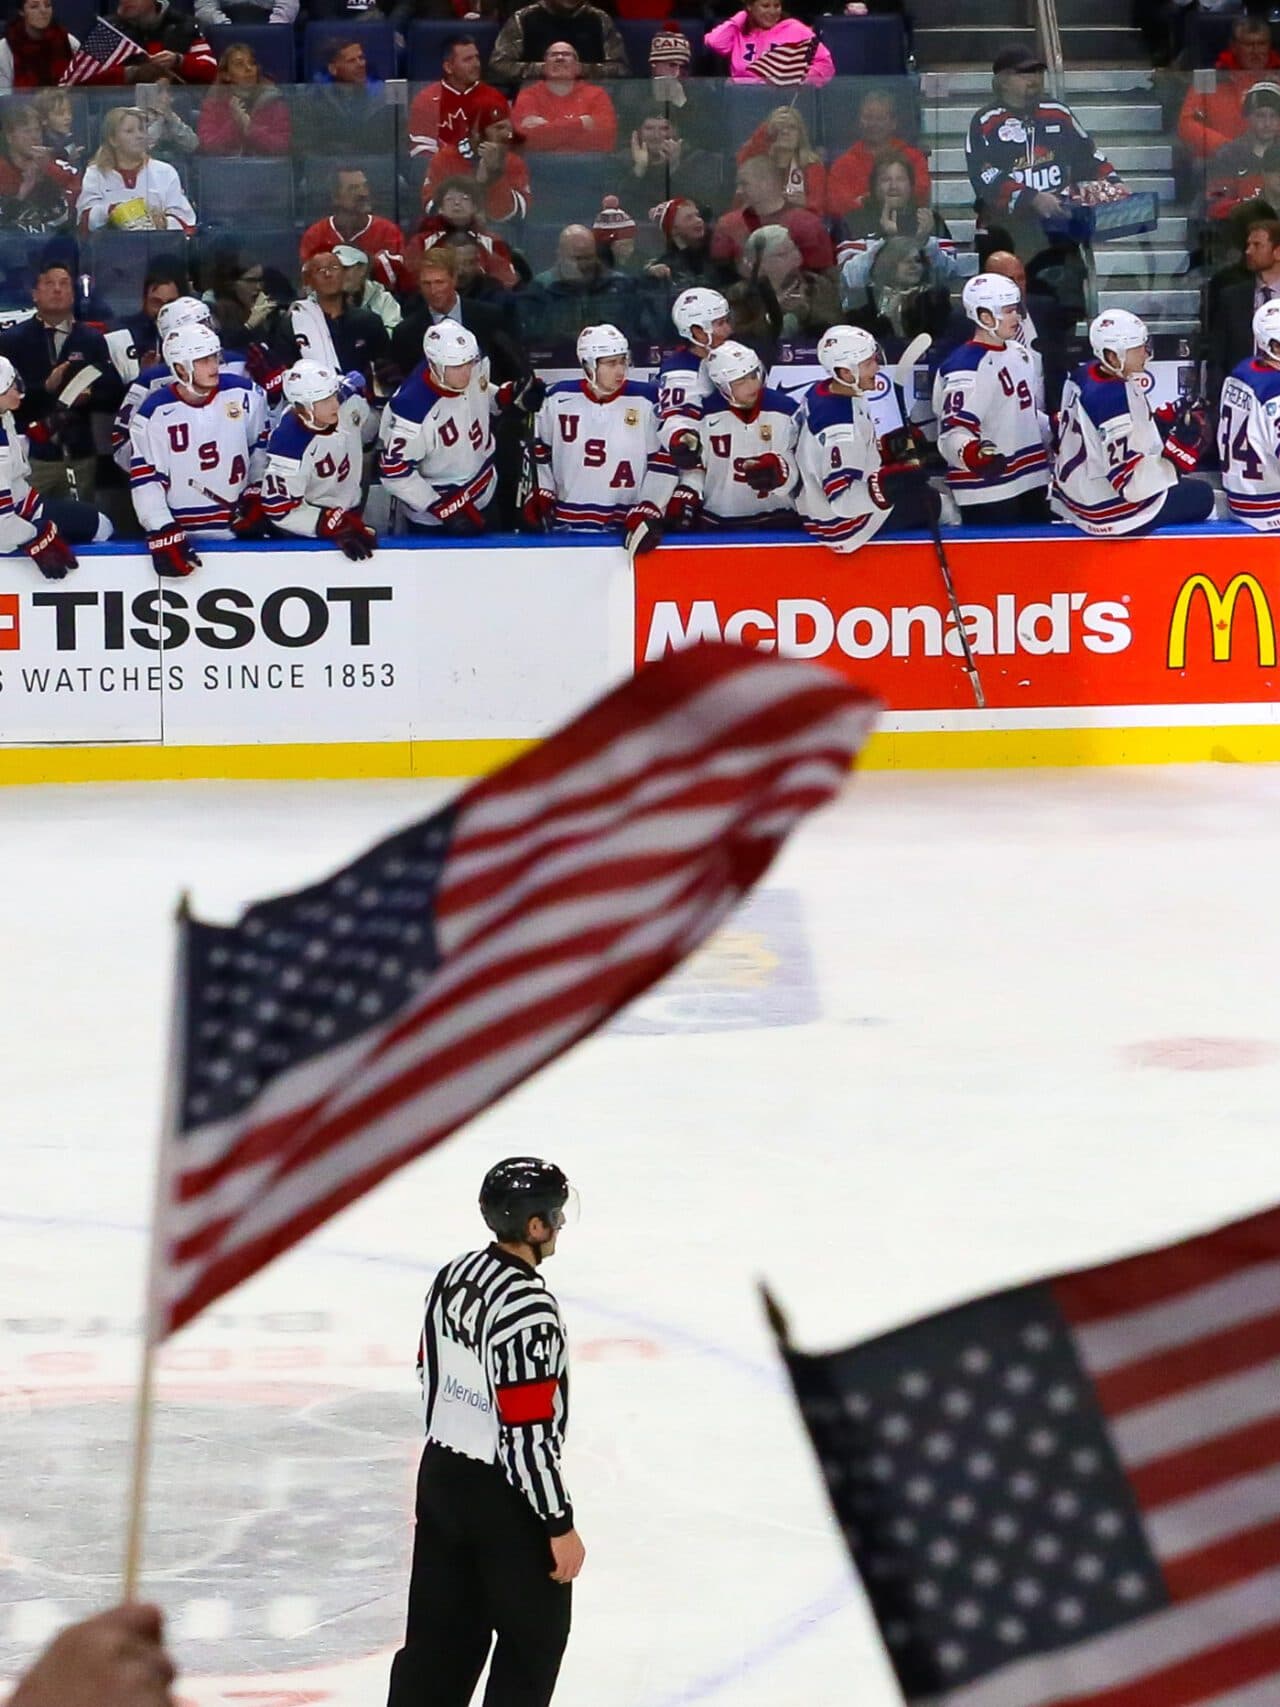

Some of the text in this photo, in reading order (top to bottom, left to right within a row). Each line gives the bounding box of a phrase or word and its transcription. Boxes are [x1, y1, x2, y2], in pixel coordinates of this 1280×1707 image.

[242, 392, 250, 413] A
[660, 387, 685, 409] 20
[167, 423, 246, 485] USA
[438, 415, 493, 452] US
[558, 414, 636, 488] USA
[1107, 437, 1129, 466] 27
[1219, 404, 1265, 481] 34
[266, 474, 288, 496] 15
[32, 586, 393, 650] TISSOT
[644, 592, 1132, 662] McDonald's
[22, 662, 396, 692] WATCHES SINCE 1853
[446, 1286, 483, 1344] 44
